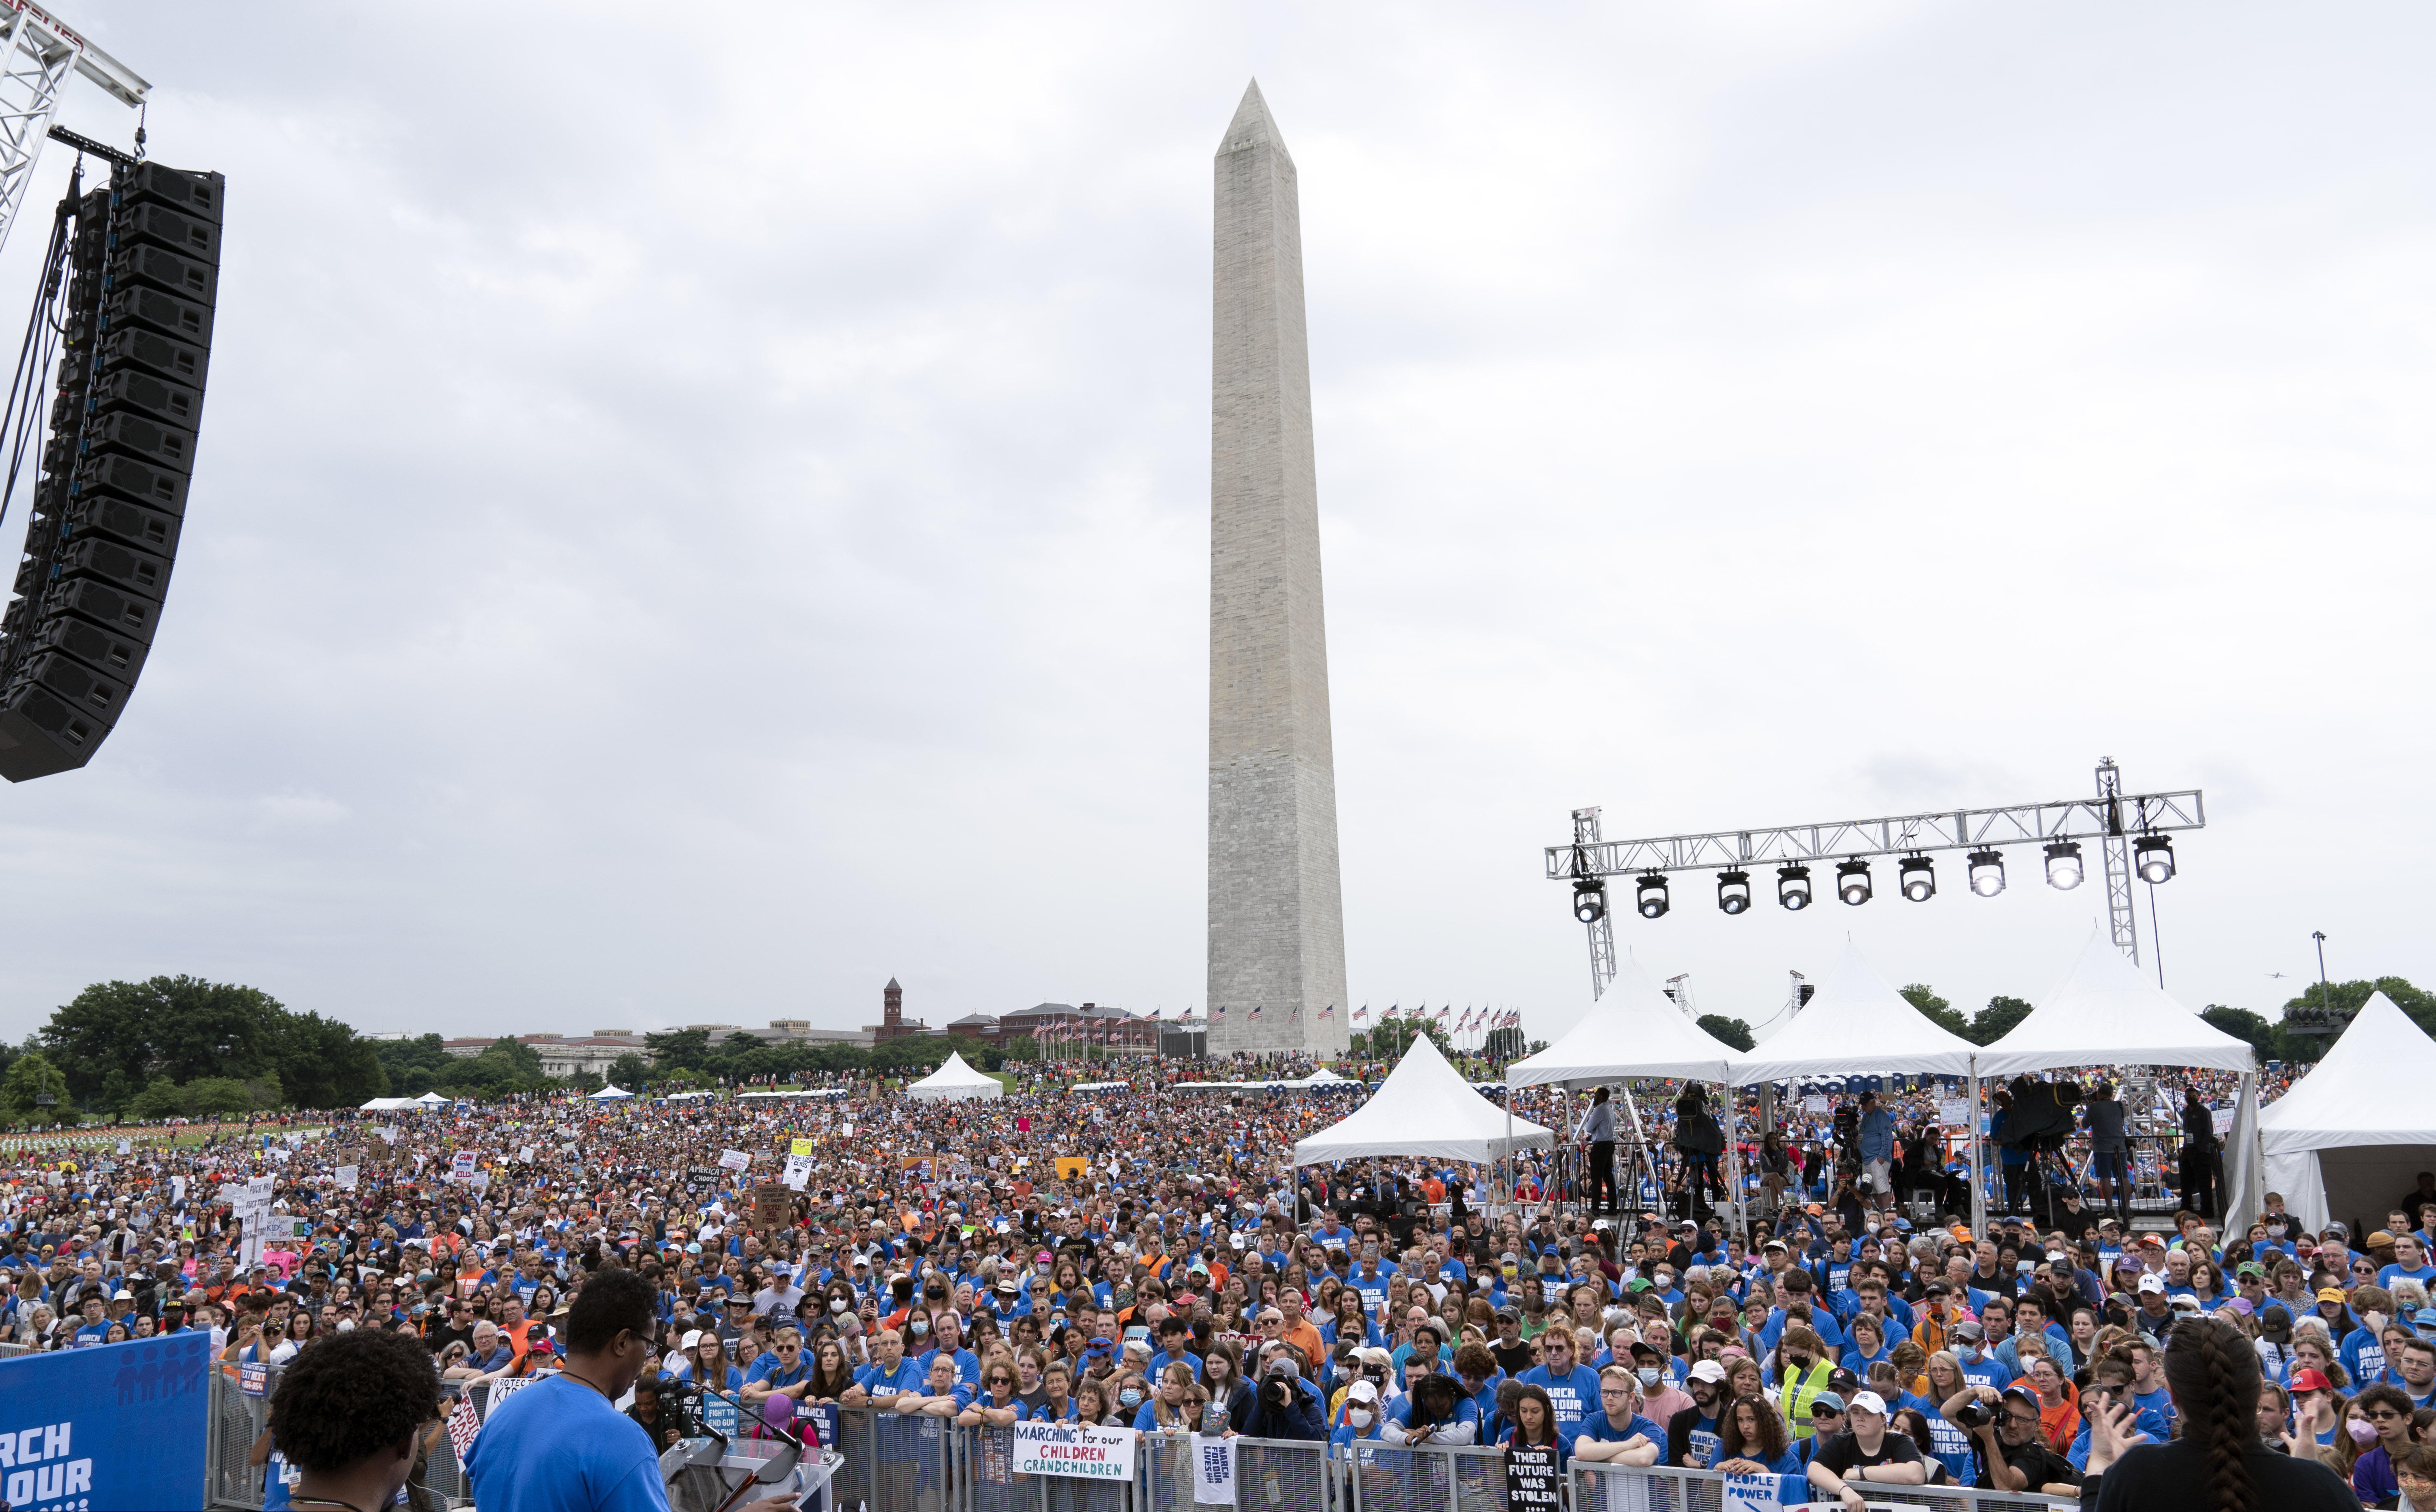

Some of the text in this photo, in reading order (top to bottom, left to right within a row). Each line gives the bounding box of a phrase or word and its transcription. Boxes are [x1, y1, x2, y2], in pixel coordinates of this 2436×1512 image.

[689, 1166, 719, 1176] AMERICA
[249, 1183, 271, 1195] FUCK NRA
[245, 1200, 258, 1210] FUCK
[245, 1213, 254, 1225] HE'S
[294, 1223, 312, 1235] DS
[1830, 1270, 1849, 1278] MARC
[2358, 1347, 2382, 1358] MAR
[241, 1369, 266, 1382] TEXT NEXT
[244, 1380, 263, 1391] 954-954
[494, 1379, 533, 1387] PROTECT
[1545, 1388, 1575, 1398] ARCH
[684, 1396, 699, 1404] HEI
[1559, 1399, 1582, 1410] OUR
[460, 1395, 480, 1440] RADIC
[708, 1408, 735, 1417] FIGHT TO
[797, 1406, 826, 1418] MARCH
[452, 1404, 472, 1452] CHANG
[708, 1418, 735, 1427] END GUN
[448, 1423, 463, 1459] NOW
[1016, 1426, 1123, 1445] MARCHING for our
[1690, 1434, 1720, 1446] MARCH
[1040, 1445, 1106, 1461] CHILDREN
[1204, 1446, 1212, 1472] LIVES
[1513, 1451, 1547, 1463] THEIR
[1024, 1459, 1122, 1476] GRANDCHILDREN
[1219, 1446, 1229, 1478] MARCH
[1213, 1465, 1223, 1484] OUR
[1509, 1464, 1554, 1477] FUTURE
[6, 1458, 92, 1507] OUR
[1520, 1478, 1546, 1489] WAS
[1726, 1473, 1774, 1486] PEOPLE
[1511, 1490, 1557, 1503] STOLEN
[1728, 1487, 1772, 1501] POWER
